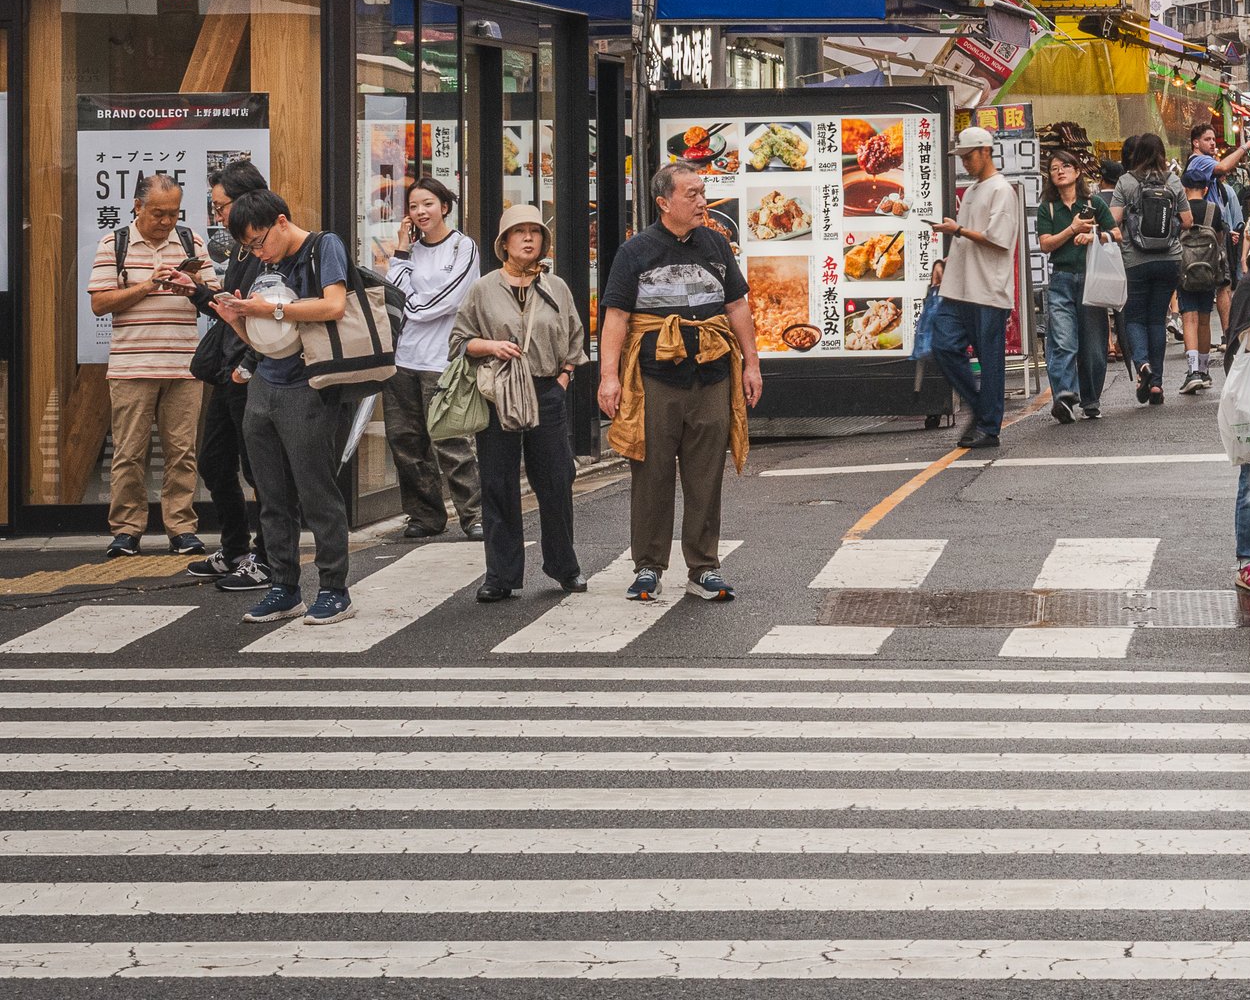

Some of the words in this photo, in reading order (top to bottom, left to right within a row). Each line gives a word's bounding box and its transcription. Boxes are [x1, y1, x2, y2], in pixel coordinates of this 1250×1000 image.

[963, 41, 990, 62] DOWNLOAD
[97, 109, 135, 118] BRAND
[139, 109, 189, 118] COLLECT
[194, 108, 249, 117] 上野御徒町店
[827, 122, 838, 153] ちくわ
[918, 118, 930, 140] 名物
[96, 150, 187, 163] オープニング
[918, 142, 931, 199] 神田旨カツ
[918, 230, 930, 271] 揚げたて
[822, 256, 838, 284] 名物
[822, 287, 839, 335] 煮込み
